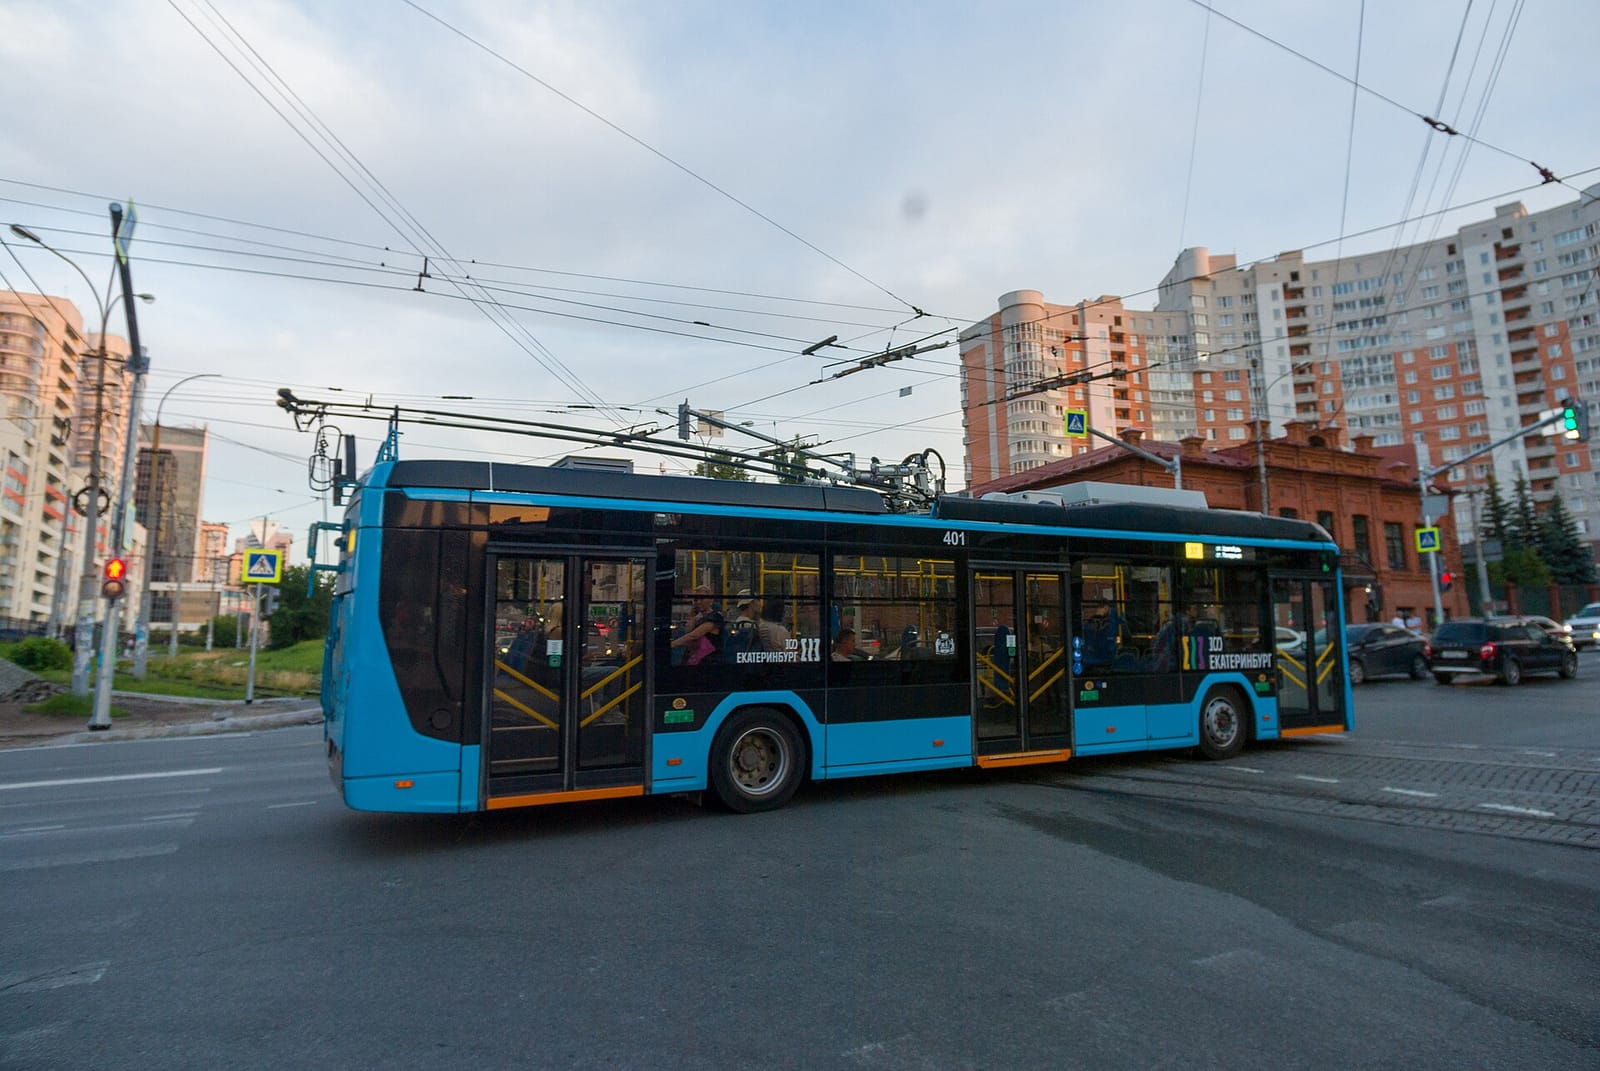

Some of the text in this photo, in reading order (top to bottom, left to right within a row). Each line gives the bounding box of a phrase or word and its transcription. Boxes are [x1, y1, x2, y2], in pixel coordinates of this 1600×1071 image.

[943, 531, 965, 546] 401
[736, 651, 799, 664] ЕКАТЕРИНБУРГ
[1209, 653, 1272, 670] ЕКАТЕРИНБУРГ
